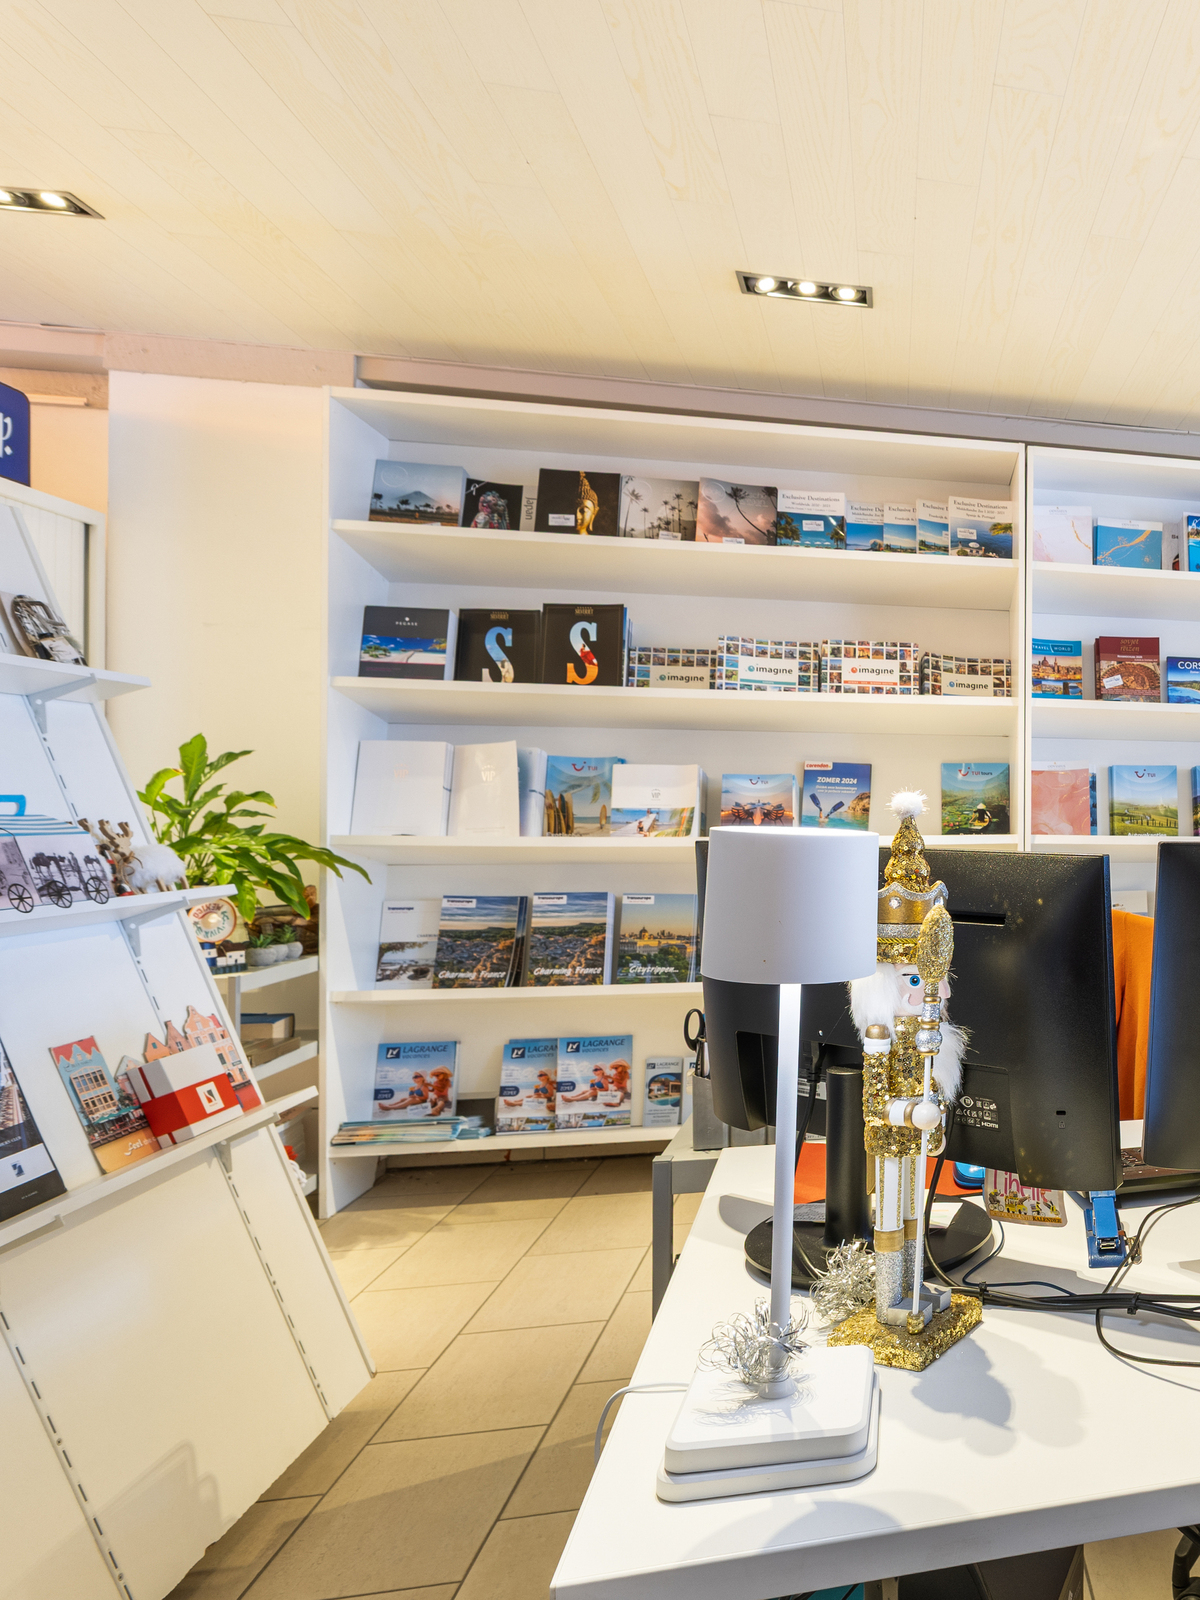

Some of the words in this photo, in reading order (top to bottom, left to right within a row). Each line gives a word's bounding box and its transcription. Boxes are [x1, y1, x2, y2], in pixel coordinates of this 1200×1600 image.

[523, 497, 537, 520] Japan
[922, 502, 945, 511] Exclusive
[953, 500, 976, 508] Exclusive
[977, 502, 1008, 510] Destinations
[755, 664, 793, 675] imagine
[858, 665, 895, 675] imagine
[667, 672, 705, 683] imagine
[955, 679, 989, 690] imagine
[394, 769, 409, 779] VIP
[481, 770, 496, 782] VIP
[193, 902, 224, 920] MEXICO
[438, 970, 476, 980] Charming
[480, 970, 506, 978] France
[533, 967, 571, 976] Charming
[575, 966, 602, 974] France
[582, 1038, 626, 1048] LAGRANGE
[402, 1045, 448, 1054] LAGRANGE
[528, 1045, 559, 1054] LAGRAN
[981, 1121, 999, 1129] HDMI
[124, 1138, 144, 1156] feel
[1032, 1215, 1063, 1224] KALENDER
